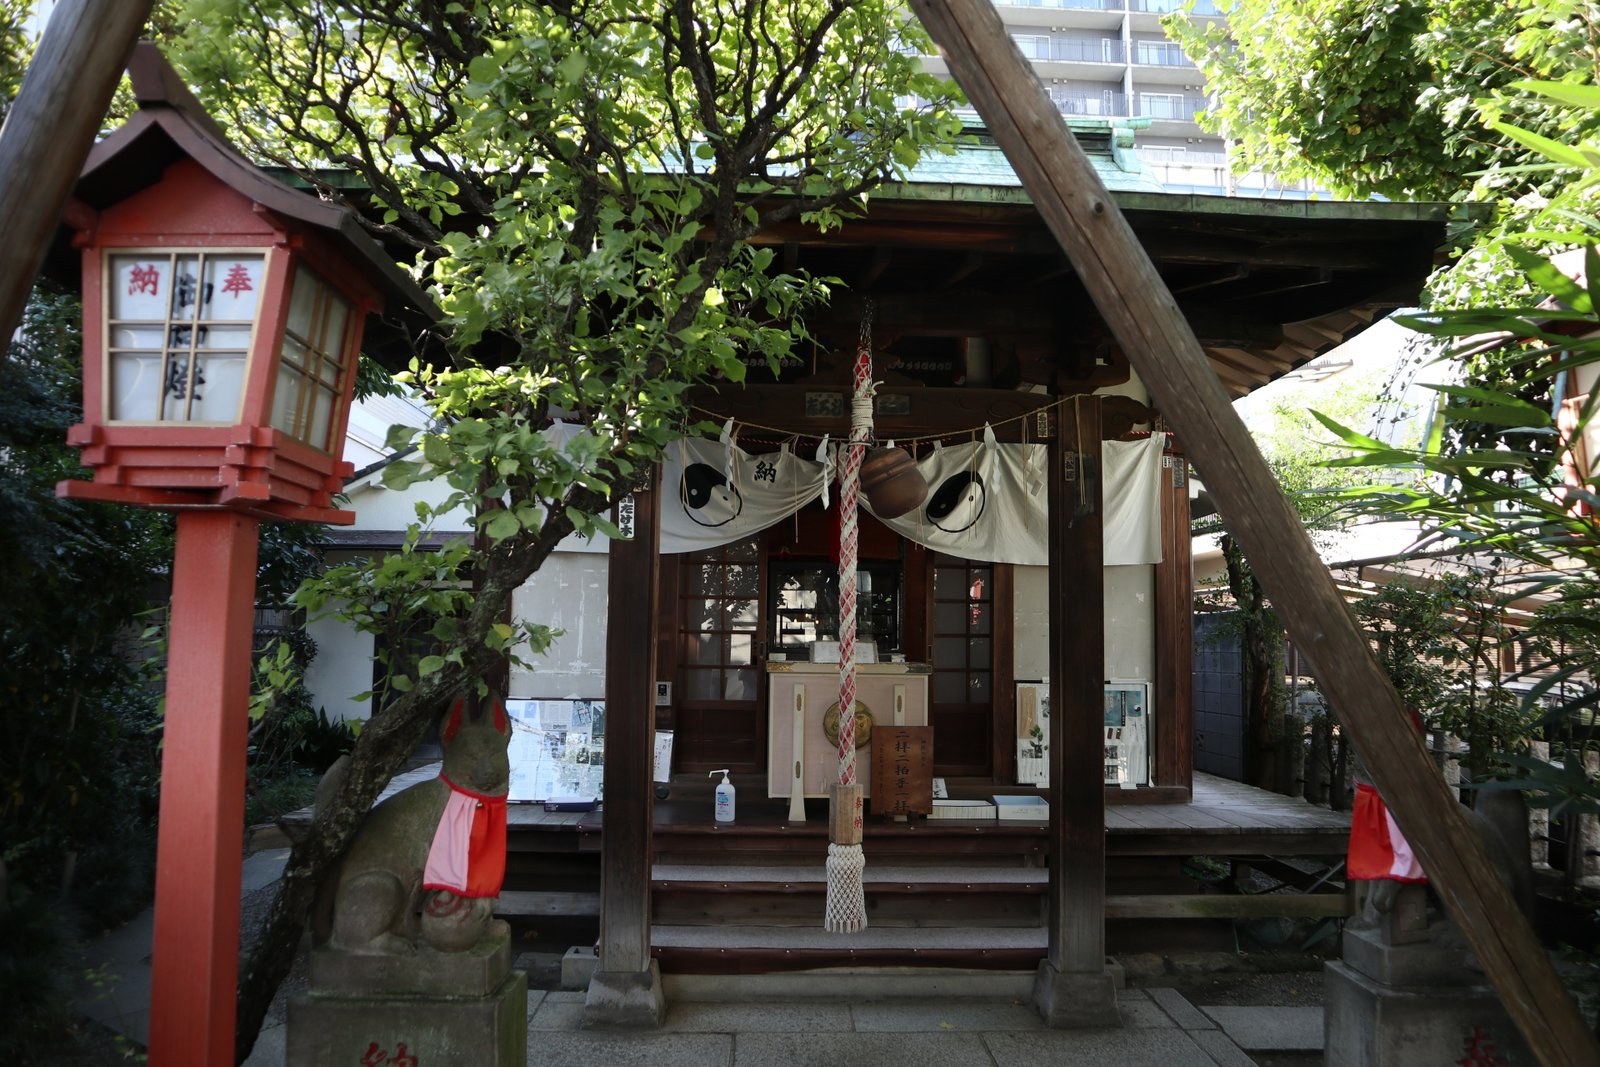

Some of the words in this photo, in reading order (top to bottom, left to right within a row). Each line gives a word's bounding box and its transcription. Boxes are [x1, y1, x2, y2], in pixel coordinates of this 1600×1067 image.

[128, 262, 160, 296] 納
[221, 262, 253, 299] 奉
[754, 461, 777, 483] 納
